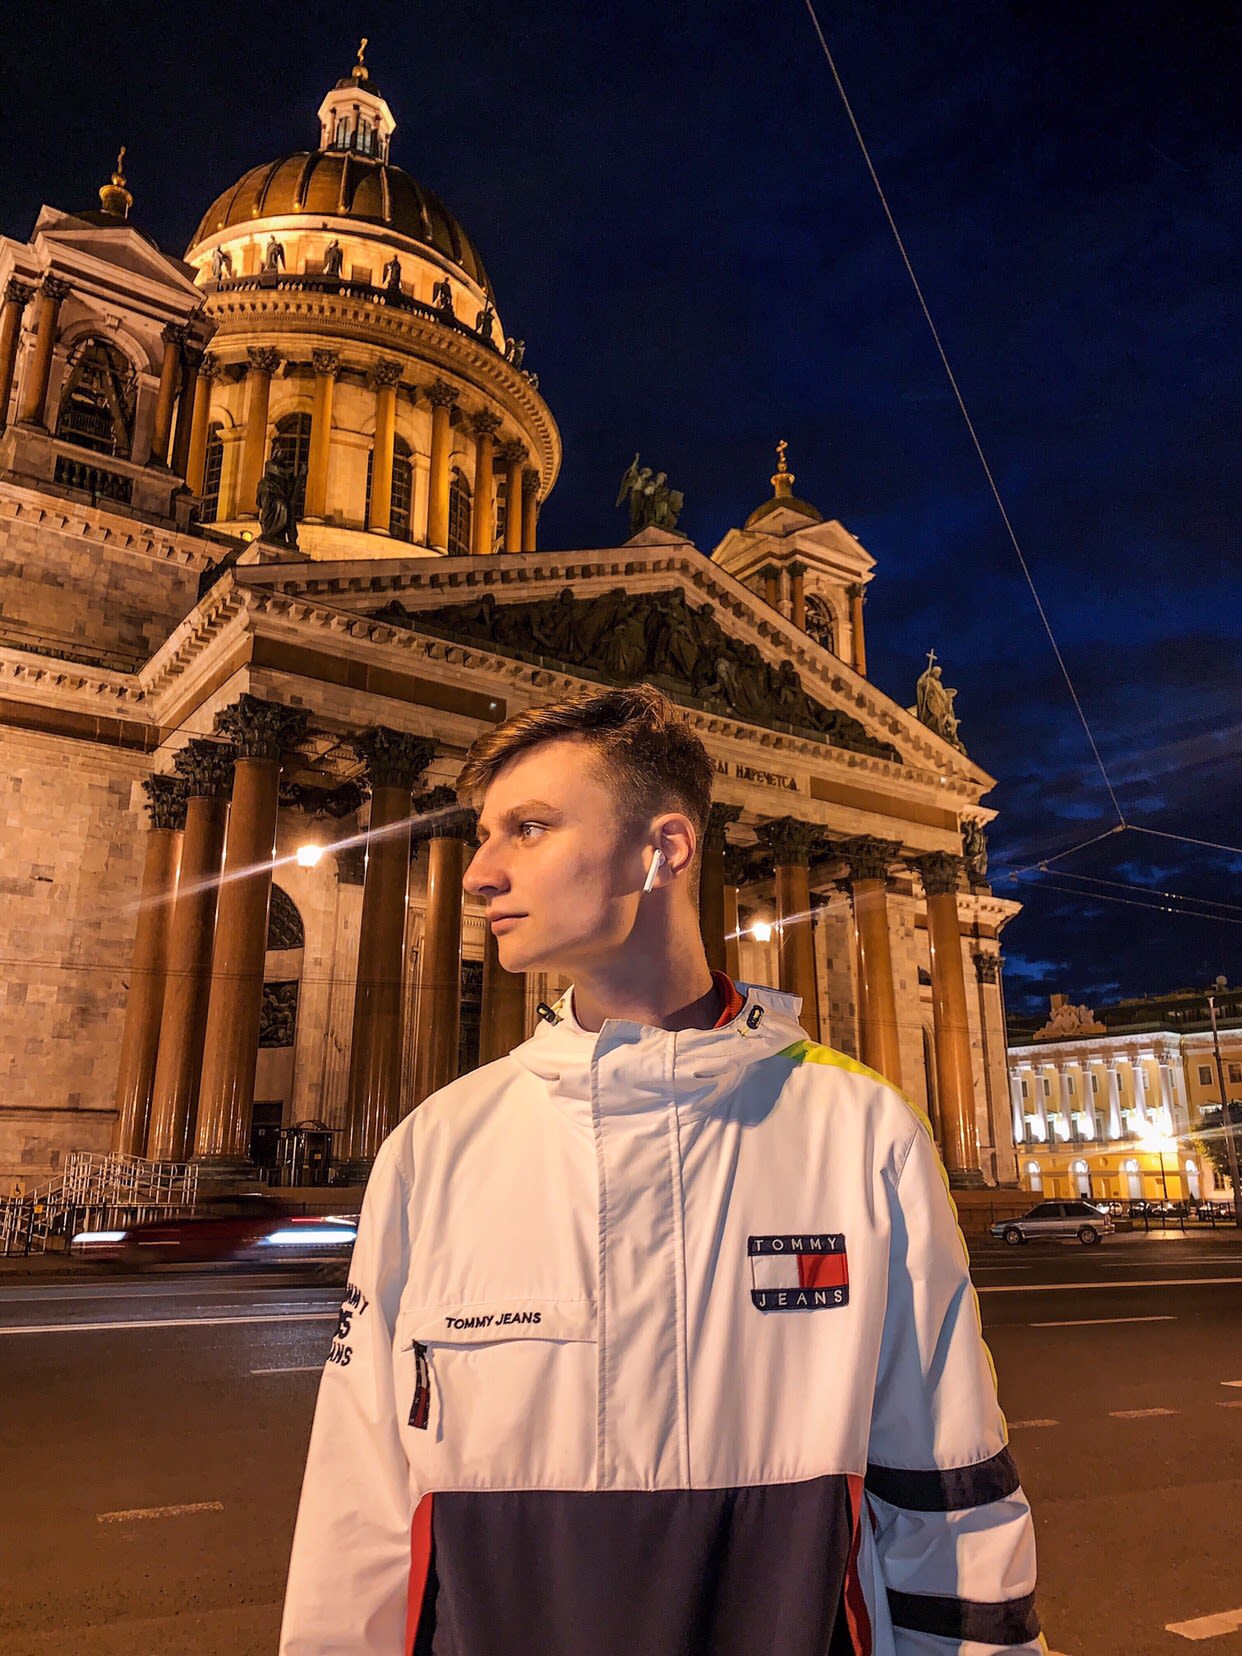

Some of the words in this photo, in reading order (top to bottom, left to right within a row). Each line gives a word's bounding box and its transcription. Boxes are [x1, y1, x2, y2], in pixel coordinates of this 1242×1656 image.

[755, 1237, 836, 1252] TOMMY
[760, 1290, 843, 1307] JEANS
[445, 1315, 494, 1329] TOMMY
[495, 1312, 541, 1326] JEANS
